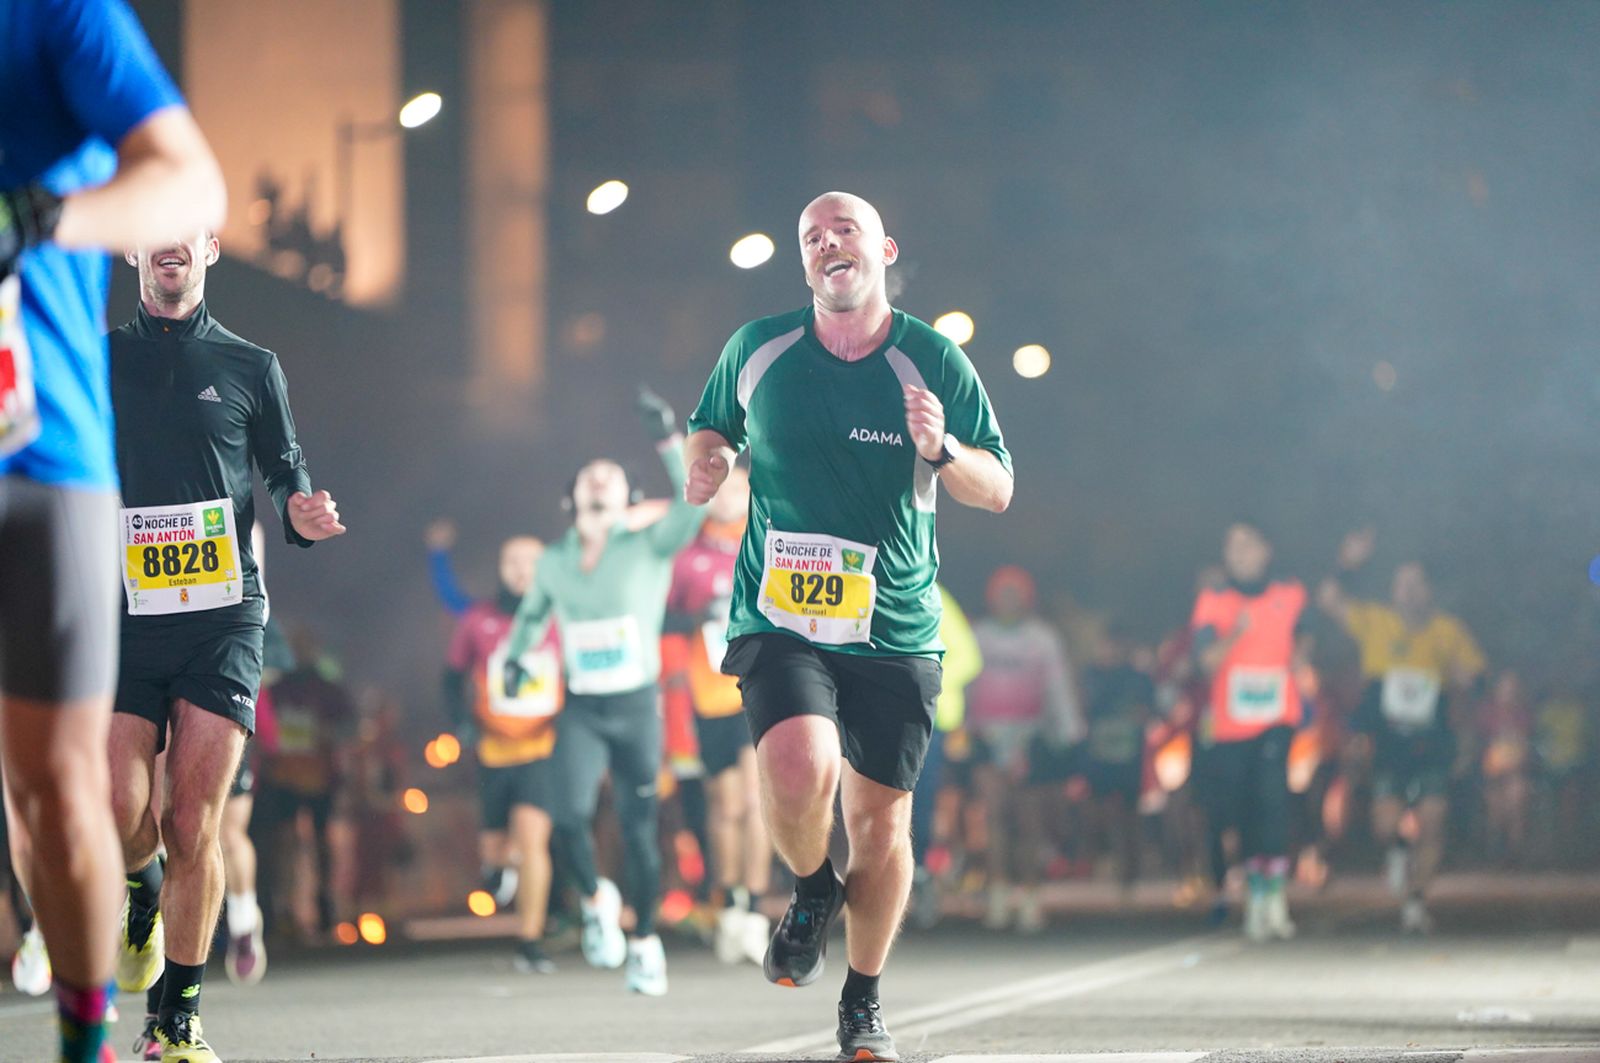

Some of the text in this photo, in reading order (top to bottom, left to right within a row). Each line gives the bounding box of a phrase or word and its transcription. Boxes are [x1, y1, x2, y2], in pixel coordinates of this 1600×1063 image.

[849, 427, 903, 447] ADAMA
[144, 517, 178, 530] NOCHE
[181, 516, 194, 527] DE
[134, 532, 154, 544] SAN
[156, 528, 195, 543] ANTÓN
[143, 540, 219, 578] 8828
[785, 545, 818, 557] NOCHE
[819, 547, 833, 558] DE
[775, 556, 833, 572] SAN ANTÓN
[168, 577, 197, 587] Esteban
[790, 573, 843, 606] 829
